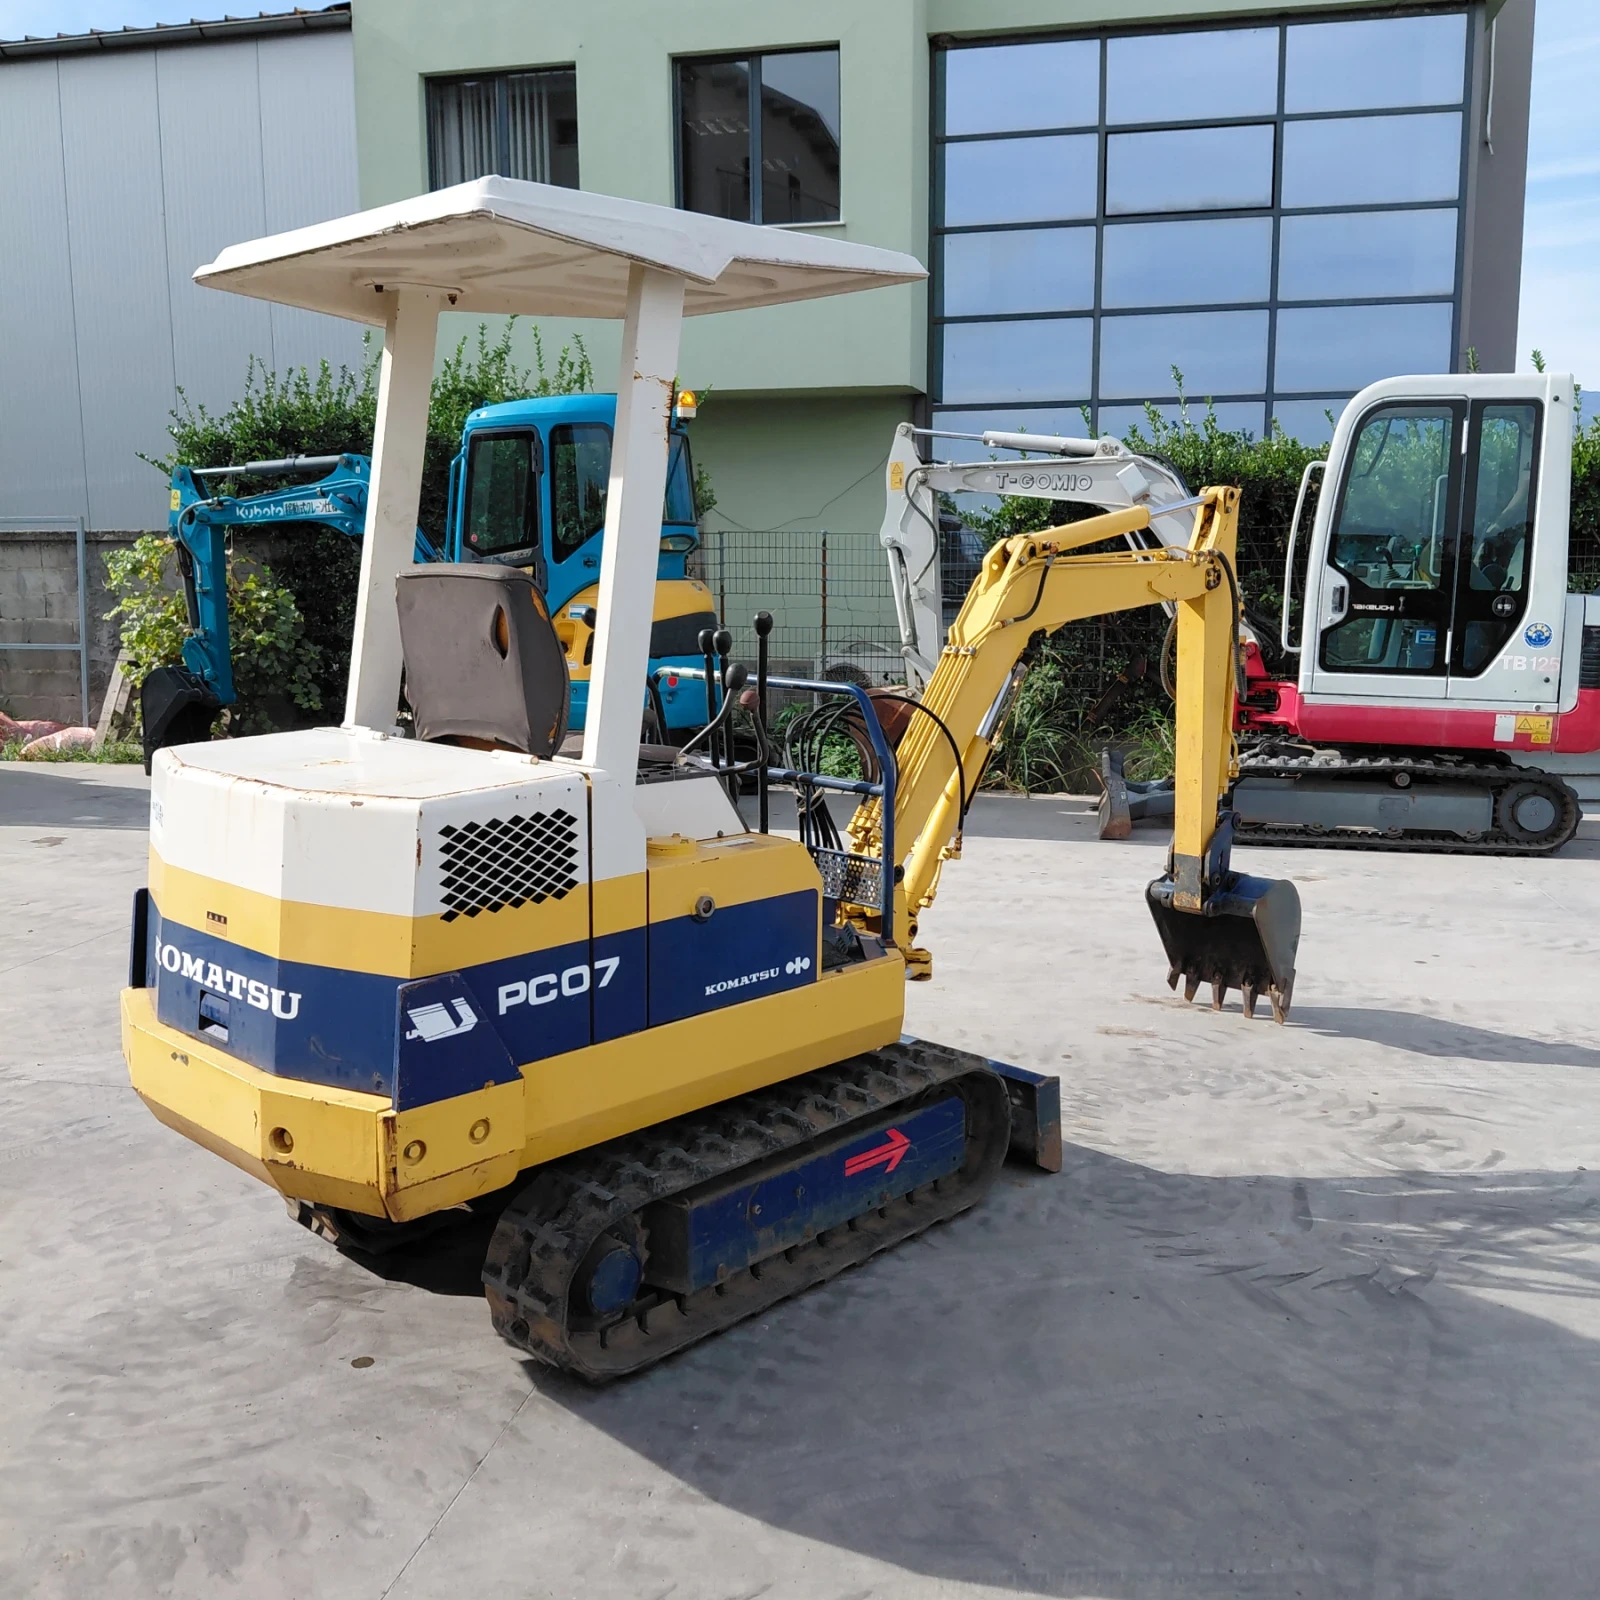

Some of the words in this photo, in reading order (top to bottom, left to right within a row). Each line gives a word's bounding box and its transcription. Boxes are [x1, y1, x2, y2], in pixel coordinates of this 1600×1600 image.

[996, 472, 1093, 492] T-GOMIO
[236, 503, 284, 519] Kubota
[498, 956, 620, 1016] PC07
[704, 967, 780, 996] KOMATSU
